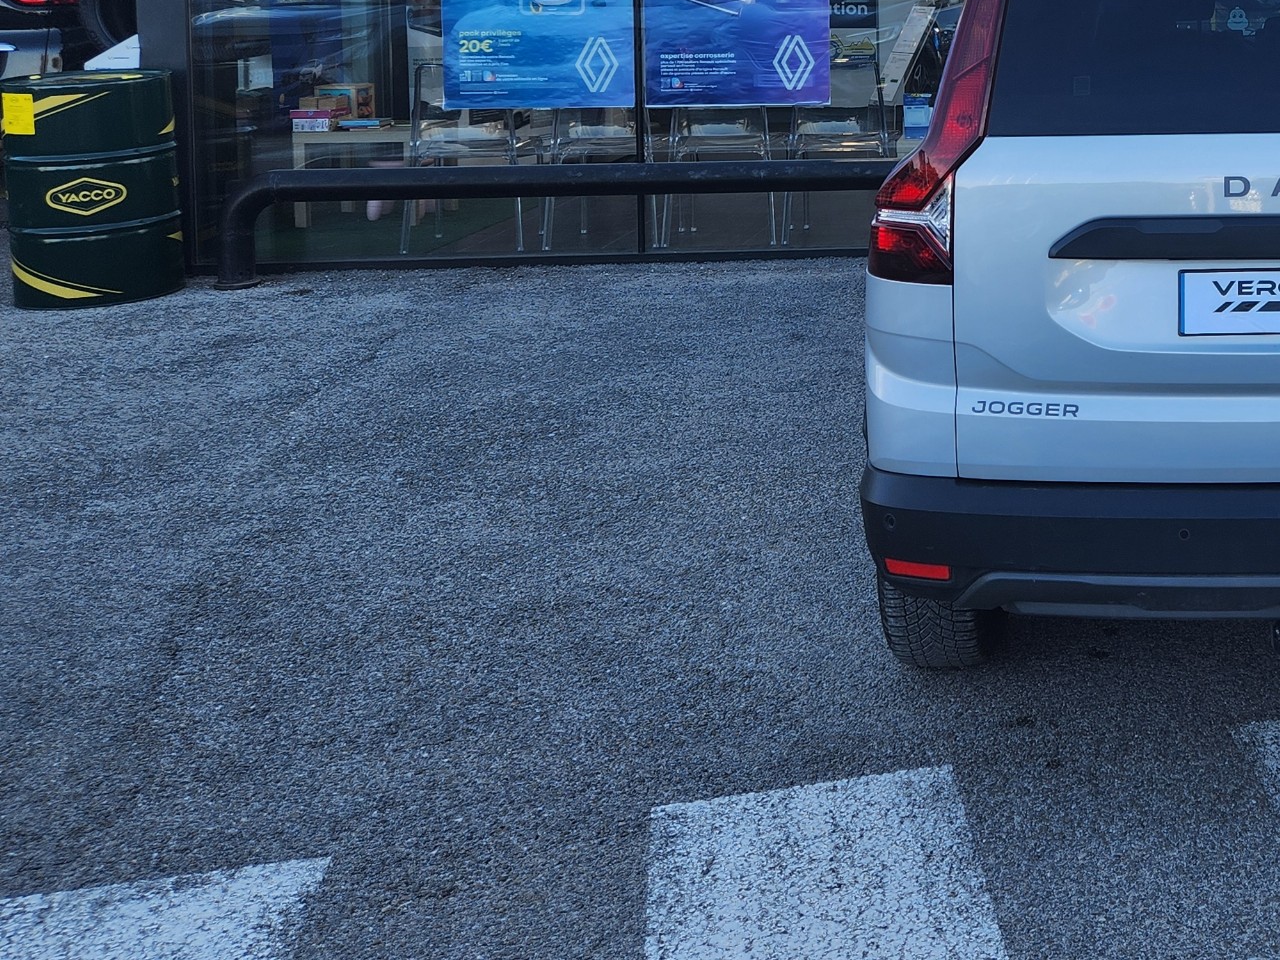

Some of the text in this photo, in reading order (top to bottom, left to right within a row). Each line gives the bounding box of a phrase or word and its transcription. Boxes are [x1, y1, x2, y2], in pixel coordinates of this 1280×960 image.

[459, 29, 479, 38] pack
[459, 39, 494, 53] 20€
[660, 52, 693, 60] expertise
[58, 188, 116, 203] YACCO
[971, 400, 1080, 418] JOGGER
